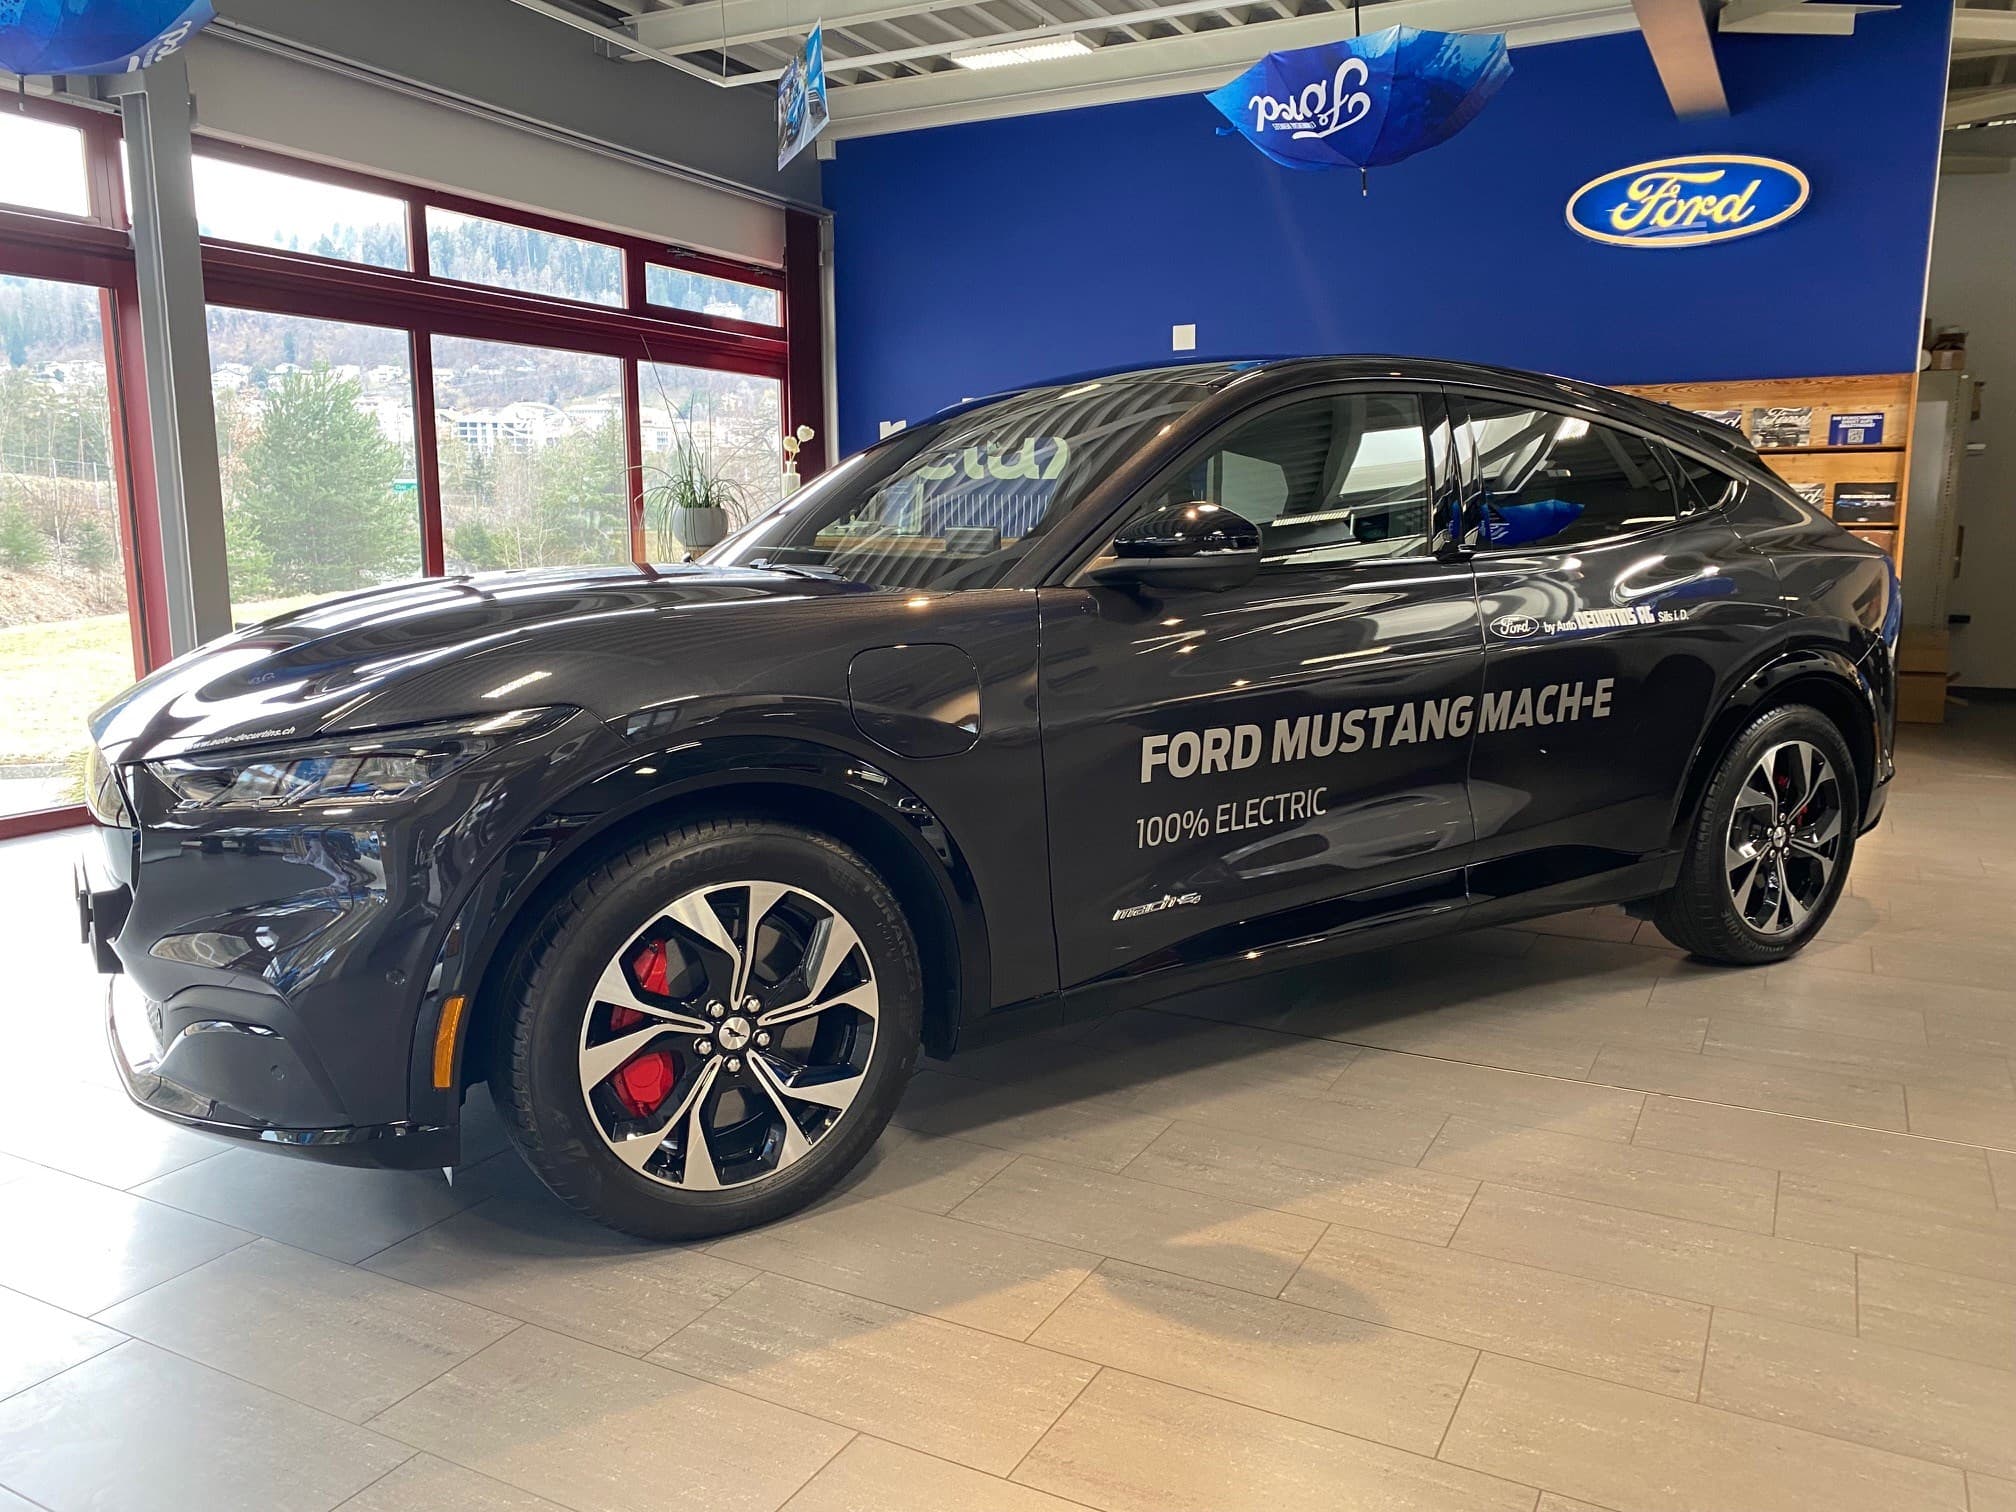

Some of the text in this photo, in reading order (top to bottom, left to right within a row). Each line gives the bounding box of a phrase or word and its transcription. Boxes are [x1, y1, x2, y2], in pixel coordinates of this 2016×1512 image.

[1248, 57, 1371, 139] Ford
[1611, 169, 1762, 231] Ford
[1543, 621, 1555, 635] by
[1556, 620, 1577, 632] Auto
[1657, 611, 1674, 622] Sils
[1140, 677, 1616, 784] FORD MUSTANG MACH-E
[1136, 786, 1328, 849] 100% ELECTRIC
